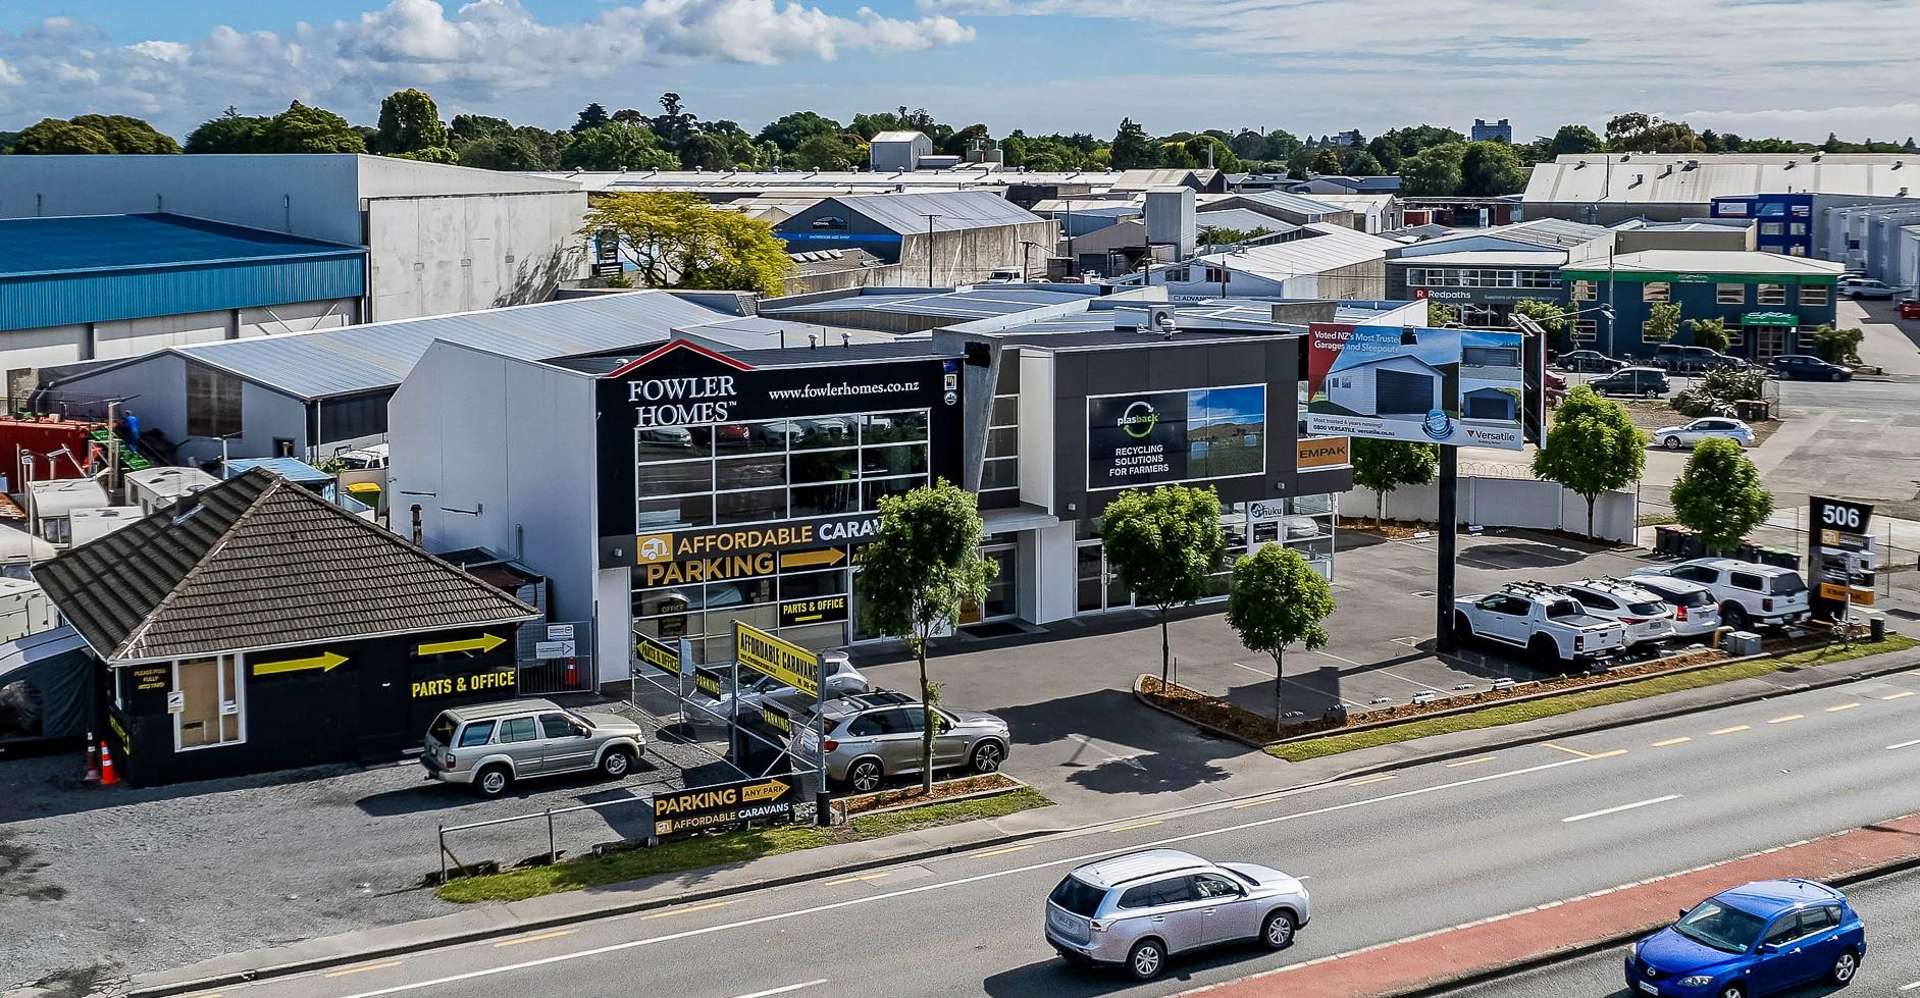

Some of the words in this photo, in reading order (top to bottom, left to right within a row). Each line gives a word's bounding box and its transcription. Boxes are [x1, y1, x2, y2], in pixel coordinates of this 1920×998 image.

[1428, 290, 1471, 300] Redpaths
[1314, 331, 1337, 340] Voted
[1337, 331, 1354, 341] NZ's
[1355, 332, 1375, 342] Most
[1314, 340, 1345, 352] Garages
[1346, 343, 1361, 351] and
[627, 375, 738, 403] FOWLER
[768, 380, 920, 402] www.fowlerhomes.co.nz
[1328, 425, 1355, 434] VERSATILE
[1475, 429, 1515, 442] Versatile
[1114, 455, 1164, 467] SOLUTIONS
[1115, 444, 1164, 457] RECYCLING
[1299, 446, 1346, 459] EMPAK
[1109, 467, 1128, 477] FOR
[1128, 463, 1170, 476] FARMERS
[1822, 504, 1860, 528] 506
[677, 525, 813, 556] AFFORDABLE
[646, 552, 775, 587] PARKING
[783, 602, 807, 615] PARTS
[808, 602, 816, 613] &
[817, 598, 845, 611] OFFICE
[740, 633, 780, 667] AFFORDABLE
[782, 651, 818, 682] CARAVANS
[412, 678, 453, 698] PARTS
[456, 676, 468, 692] &
[470, 671, 516, 691] OFFICE
[696, 673, 720, 695] PARKING
[763, 709, 789, 733] PARKING
[655, 788, 737, 816] PARKING
[743, 789, 761, 798] ANY
[762, 785, 785, 796] PARK
[673, 811, 736, 831] AFFORDABLE
[738, 802, 789, 819] CARAVANS
